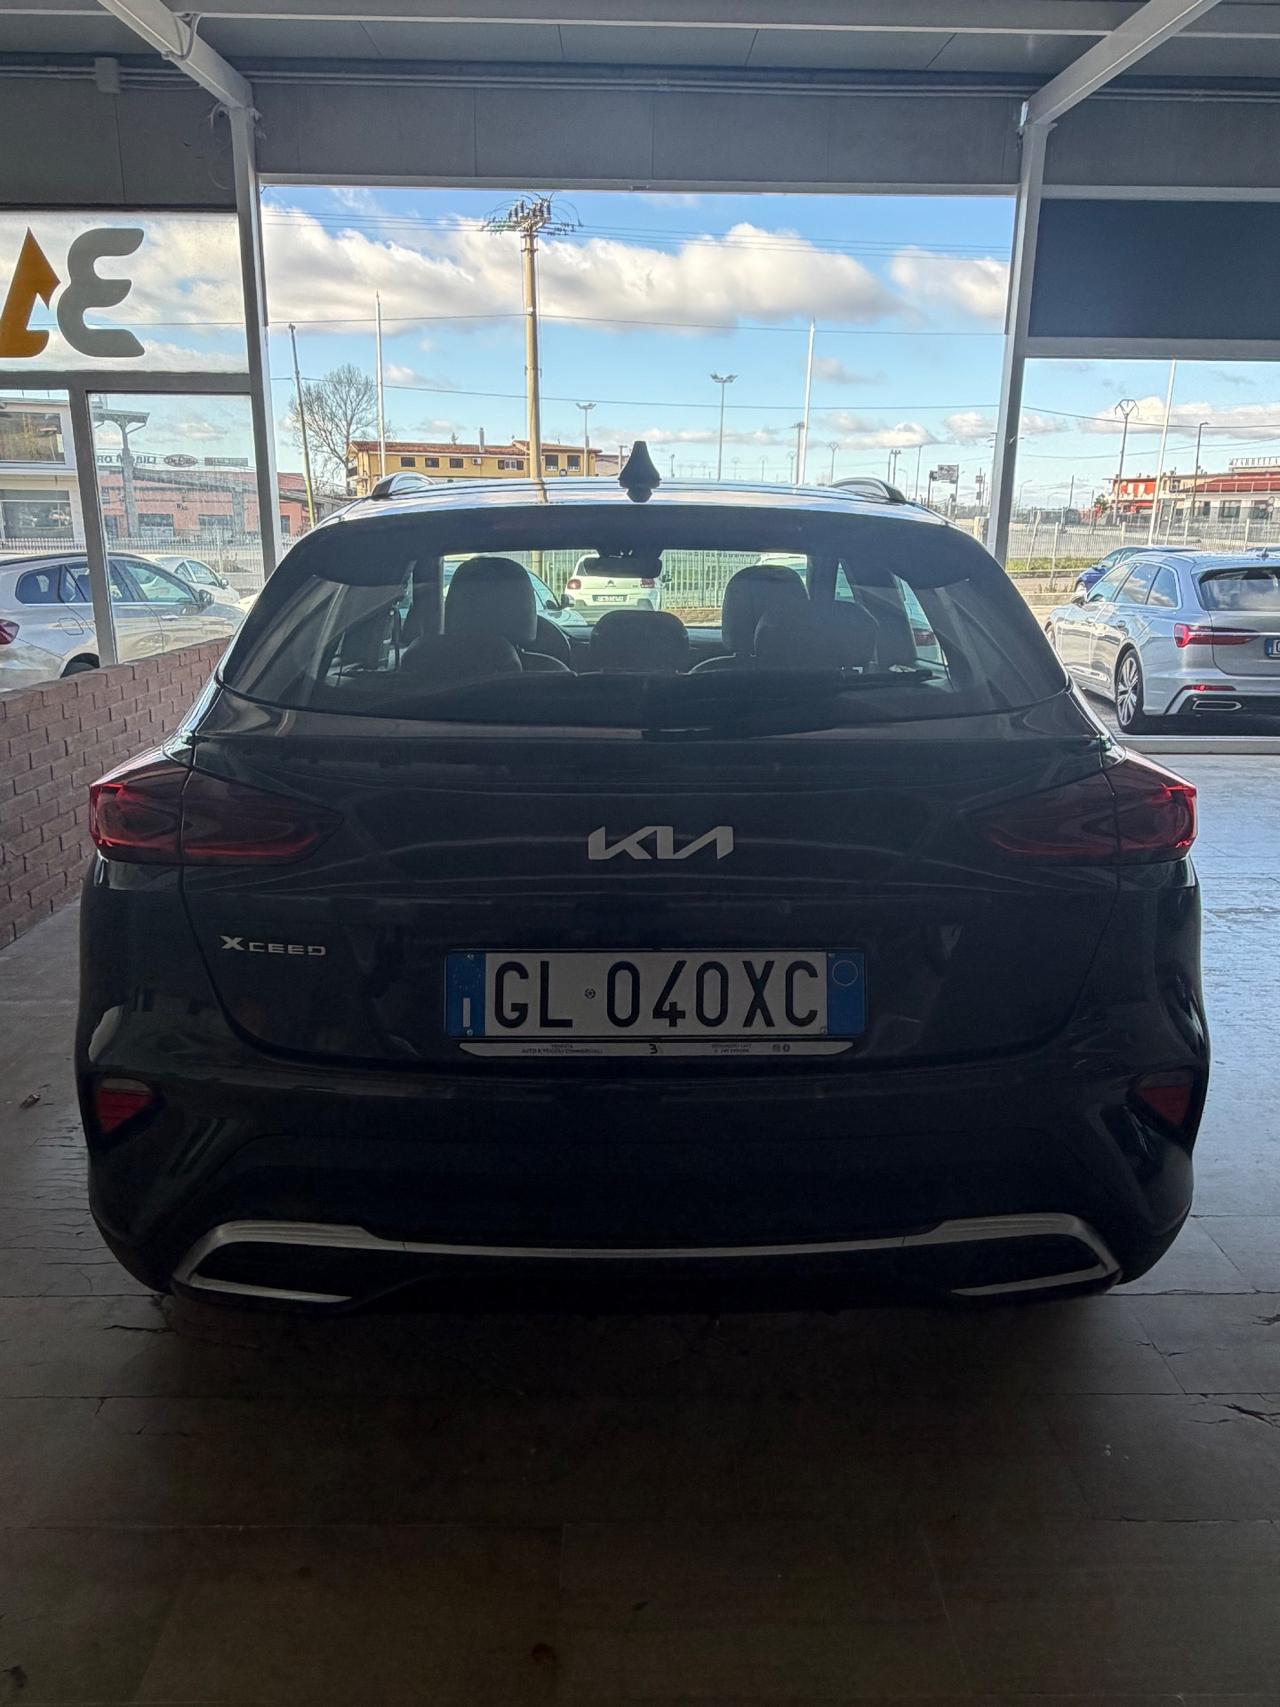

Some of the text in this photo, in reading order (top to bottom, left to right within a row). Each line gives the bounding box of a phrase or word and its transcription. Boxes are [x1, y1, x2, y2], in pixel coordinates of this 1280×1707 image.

[587, 825, 735, 861] KIA
[219, 935, 327, 957] XCEED
[493, 960, 574, 1028] GL
[606, 960, 820, 1028] 040XC
